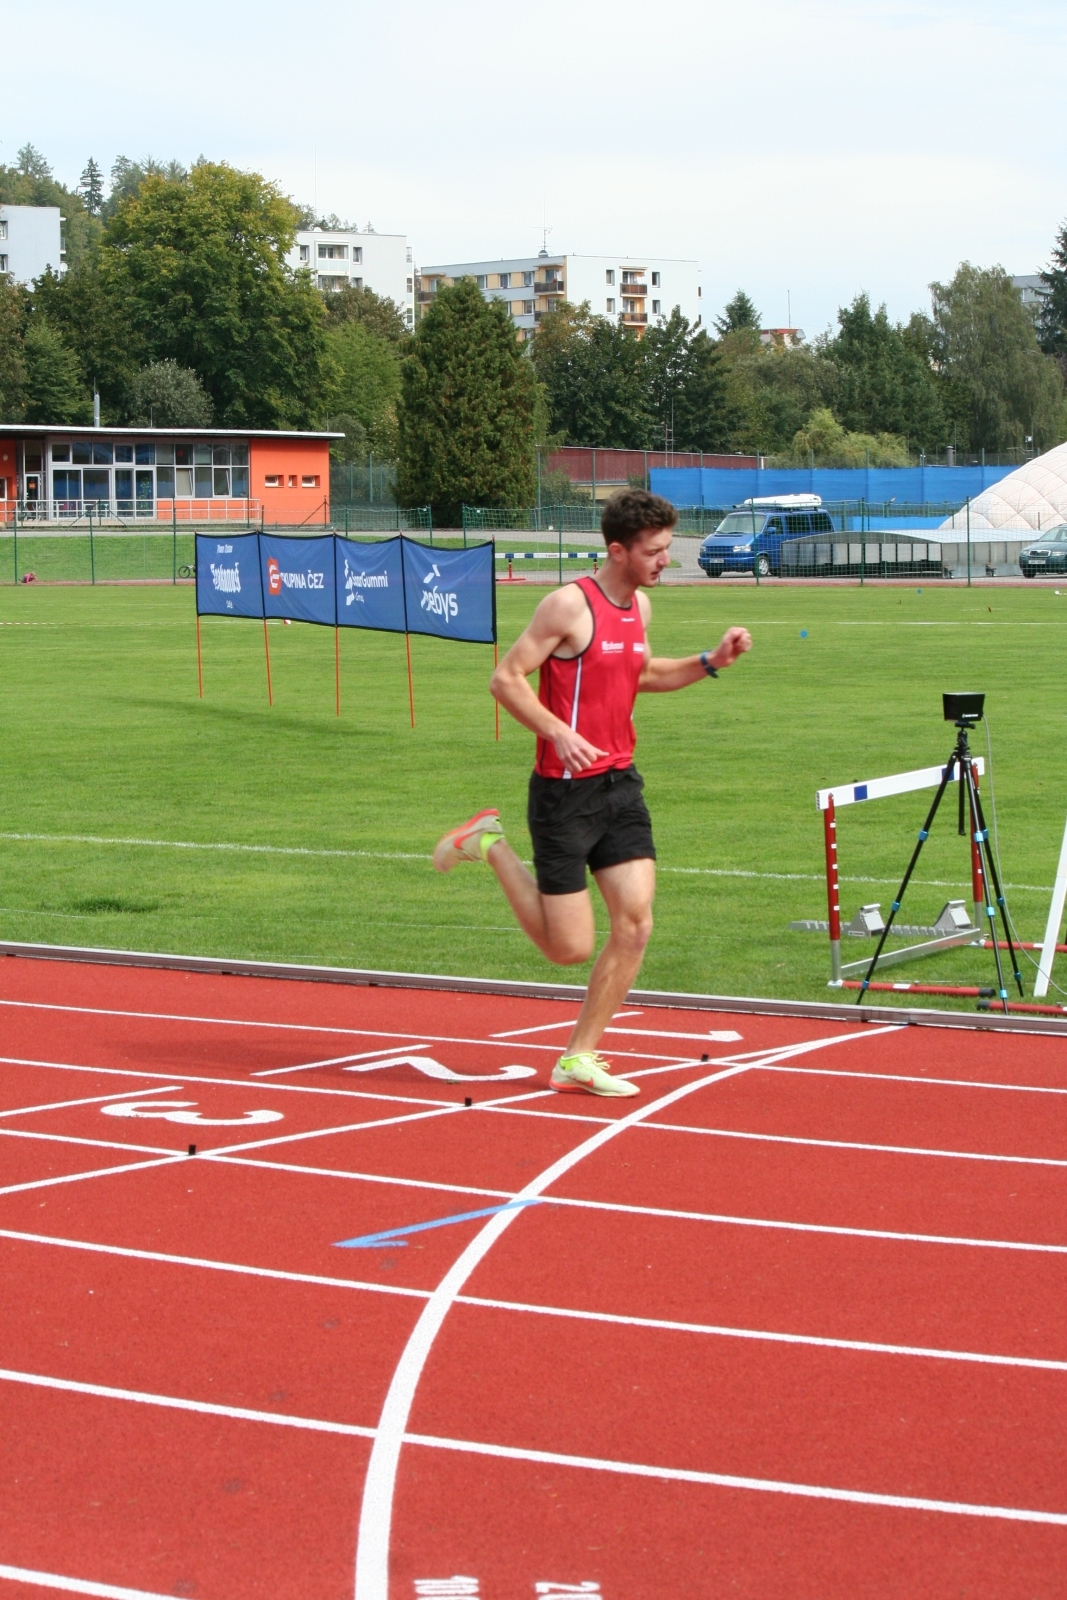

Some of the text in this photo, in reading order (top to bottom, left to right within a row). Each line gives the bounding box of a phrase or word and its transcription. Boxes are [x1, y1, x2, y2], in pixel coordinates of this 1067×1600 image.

[307, 569, 325, 589] ČEZ
[343, 1055, 537, 1082] 2
[100, 1101, 284, 1126] 3
